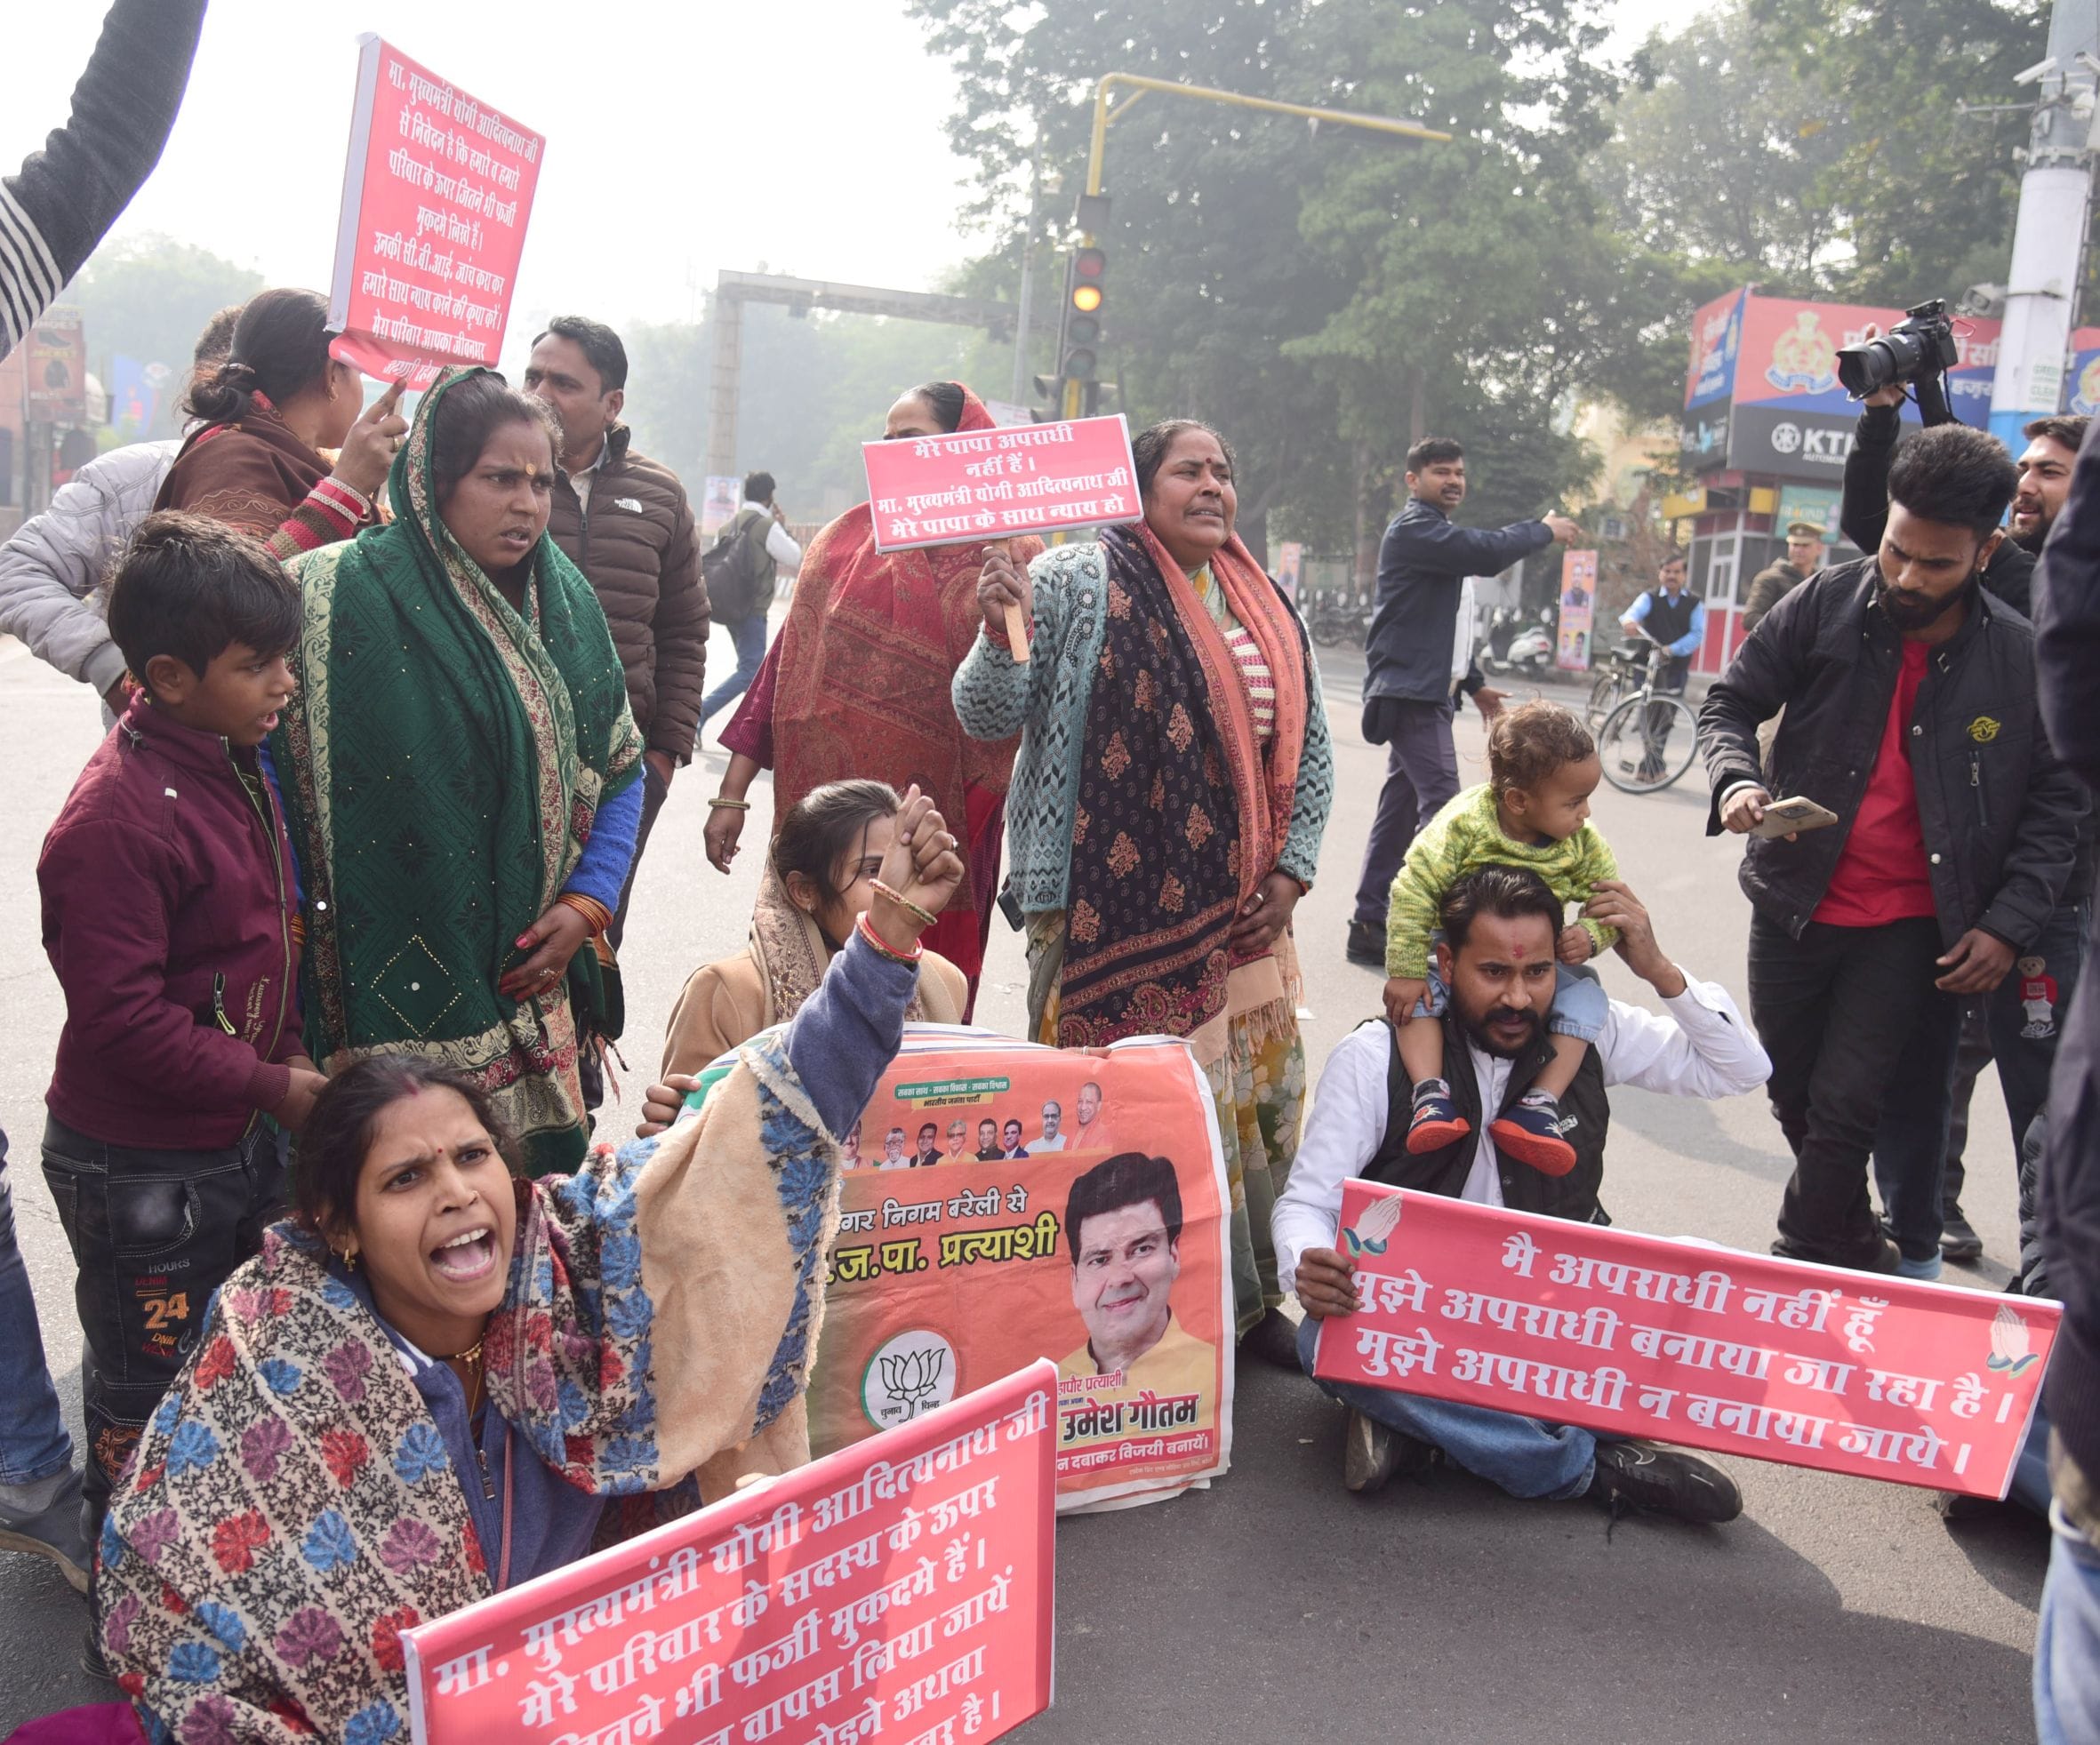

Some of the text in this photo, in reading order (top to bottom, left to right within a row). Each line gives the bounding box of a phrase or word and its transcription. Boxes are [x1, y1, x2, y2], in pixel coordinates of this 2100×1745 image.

[399, 105, 411, 137] से
[411, 112, 446, 155] निवेदन
[446, 128, 454, 160] है
[455, 136, 469, 164] कि
[469, 149, 492, 178] हमारे
[499, 165, 521, 192] हमारे
[453, 93, 478, 130] योगी
[477, 113, 525, 156] आदित्यनाथ
[524, 138, 539, 164] जी
[389, 148, 517, 228] परिवार के ऊपर जितने भी फर्जी
[416, 205, 448, 236] मुकदमे
[373, 231, 402, 262] उनकी
[362, 268, 388, 299] हमारे
[388, 278, 410, 305] साथ
[410, 284, 434, 311] न्याय
[432, 290, 453, 318] करने
[452, 294, 468, 321] की
[466, 300, 486, 331] कृपा
[372, 308, 392, 340] मेरा
[391, 316, 423, 348] परिवार
[421, 328, 453, 355] आपका
[913, 424, 1074, 460] मेरे पापा अपराधी
[965, 454, 1004, 478] नहीं
[906, 484, 973, 514] मुख्यमंत्री
[974, 480, 1014, 503] योगी
[1016, 471, 1103, 499] आदित्यनाथ
[1105, 467, 1129, 487] जी
[889, 493, 1126, 540] मेरे पापा के साथ न्याय हो
[837, 1184, 1028, 1234] गर निगम बरेली से
[148, 1258, 191, 1274] HOURS
[939, 1212, 1059, 1269] प्रत्याशी
[144, 1292, 190, 1329] 24
[1549, 1252, 1738, 1315] अपराधी
[1743, 1287, 1843, 1334] नहीं
[1842, 1295, 1890, 1354] हूँ
[1440, 1286, 1623, 1351] अपराधी
[1630, 1323, 1779, 1381] बनाया
[1783, 1352, 1857, 1396] जा
[1864, 1367, 1944, 1413] रहा
[1086, 1368, 1122, 1390] प्रत्याशी
[1355, 1326, 1444, 1378] मुझे
[1451, 1347, 1633, 1412] अपराधी
[1638, 1383, 1680, 1421] न
[1686, 1391, 1834, 1451] बनाया
[880, 1405, 902, 1421] चुनाव
[1061, 1390, 1199, 1441] उमेश गौतम
[1071, 1449, 1117, 1469] दबाकर
[1118, 1438, 1165, 1461] विजयी
[432, 1389, 1051, 1697] मा. मुख्यमंत्री योगी आदित्यनाथ जी
[518, 1475, 1000, 1728] मेरे परिवार के सदस्य के ऊपर
[675, 1662, 725, 1718] भी
[728, 1608, 823, 1689] फर्जी
[829, 1556, 940, 1652] मुकदमे
[741, 1565, 1015, 1742] वापस लिया जायें
[893, 1645, 987, 1722] अथवा
